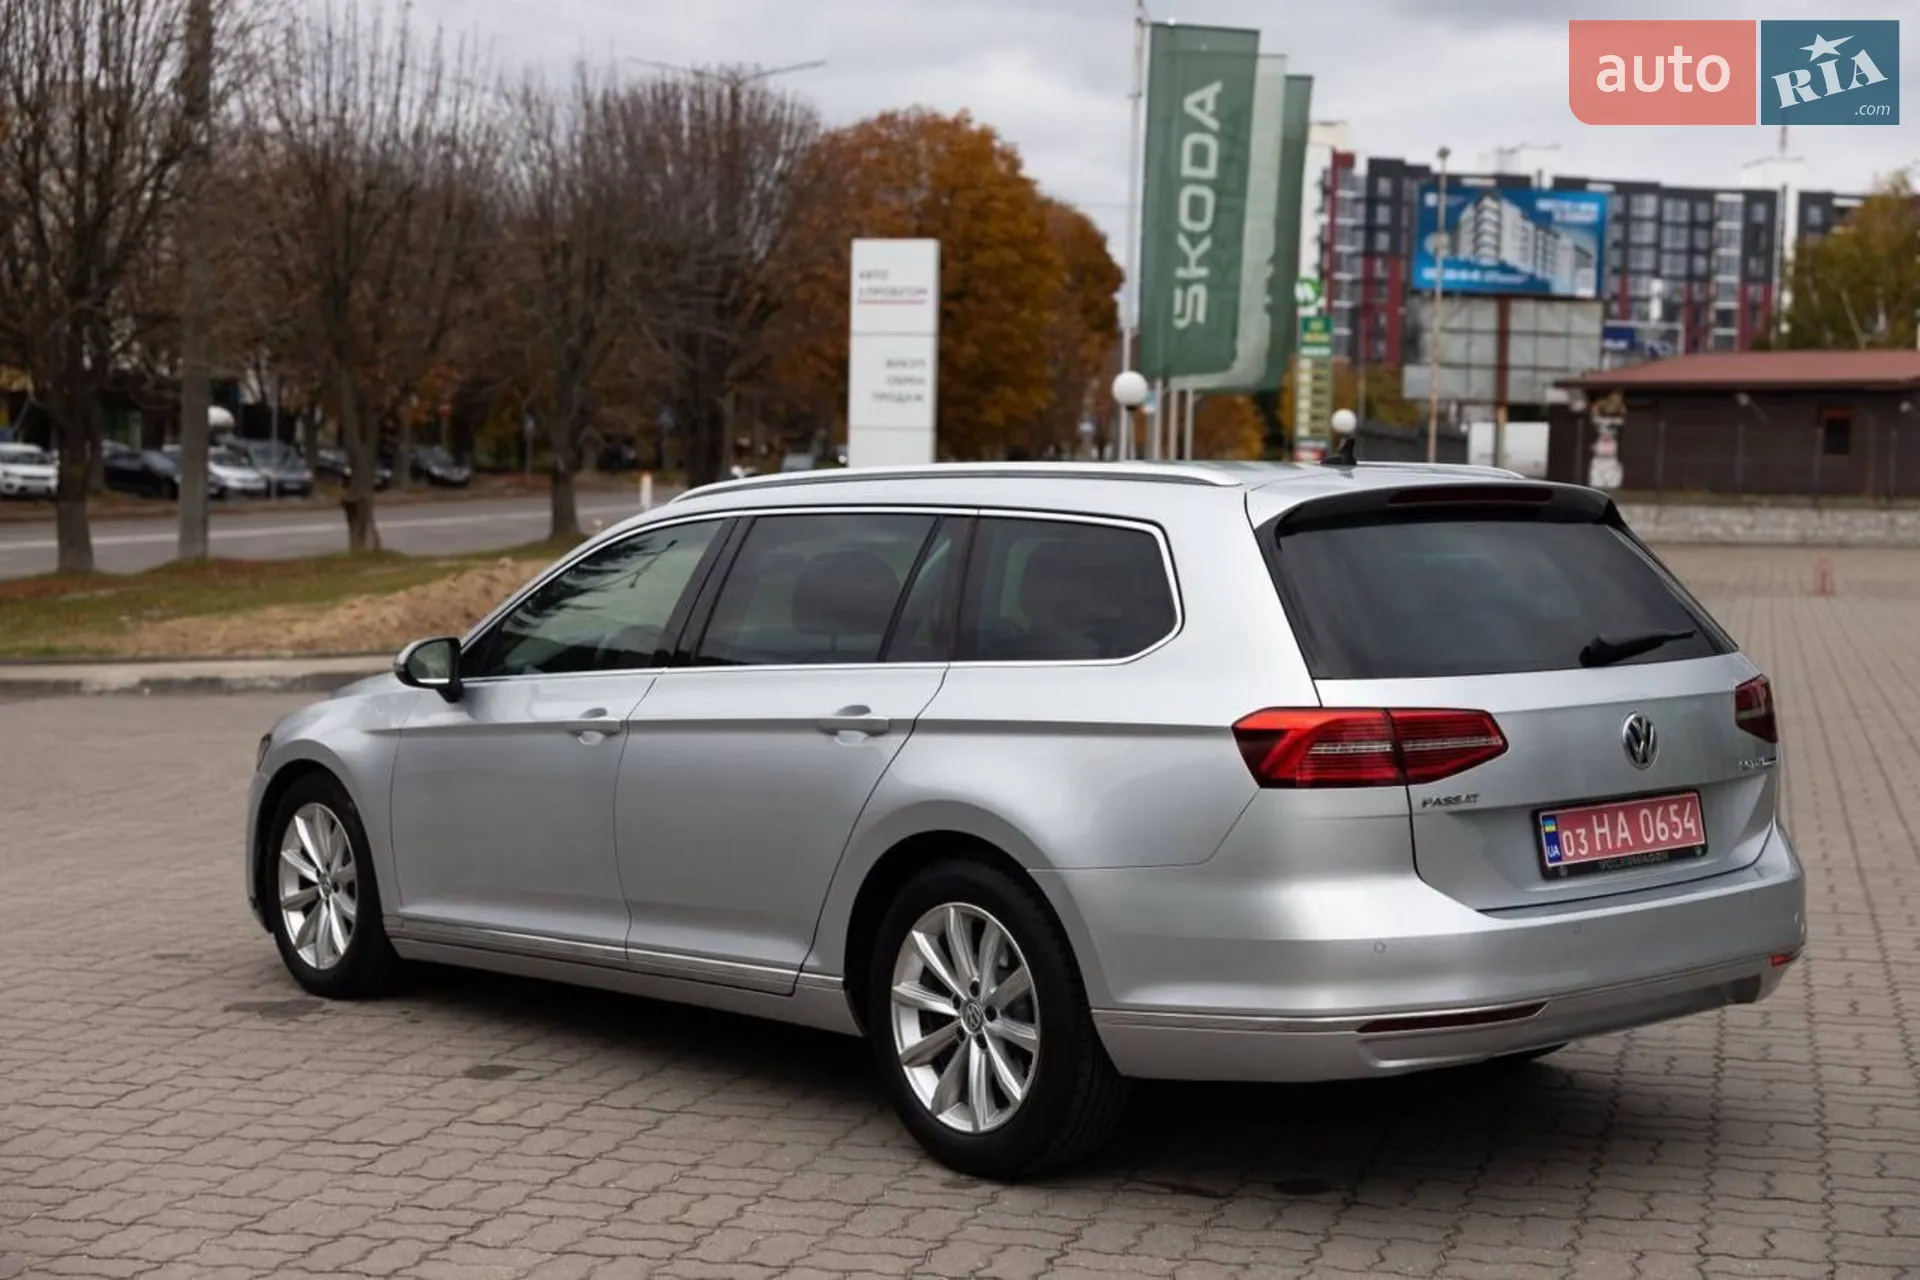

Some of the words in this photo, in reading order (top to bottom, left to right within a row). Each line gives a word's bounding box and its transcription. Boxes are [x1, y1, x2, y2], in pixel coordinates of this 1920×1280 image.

[1422, 792, 1480, 808] PASSAT
[1562, 829, 1589, 857] 03
[1592, 811, 1633, 851] HA
[1639, 802, 1697, 844] 0654
[1547, 844, 1561, 858] UA
